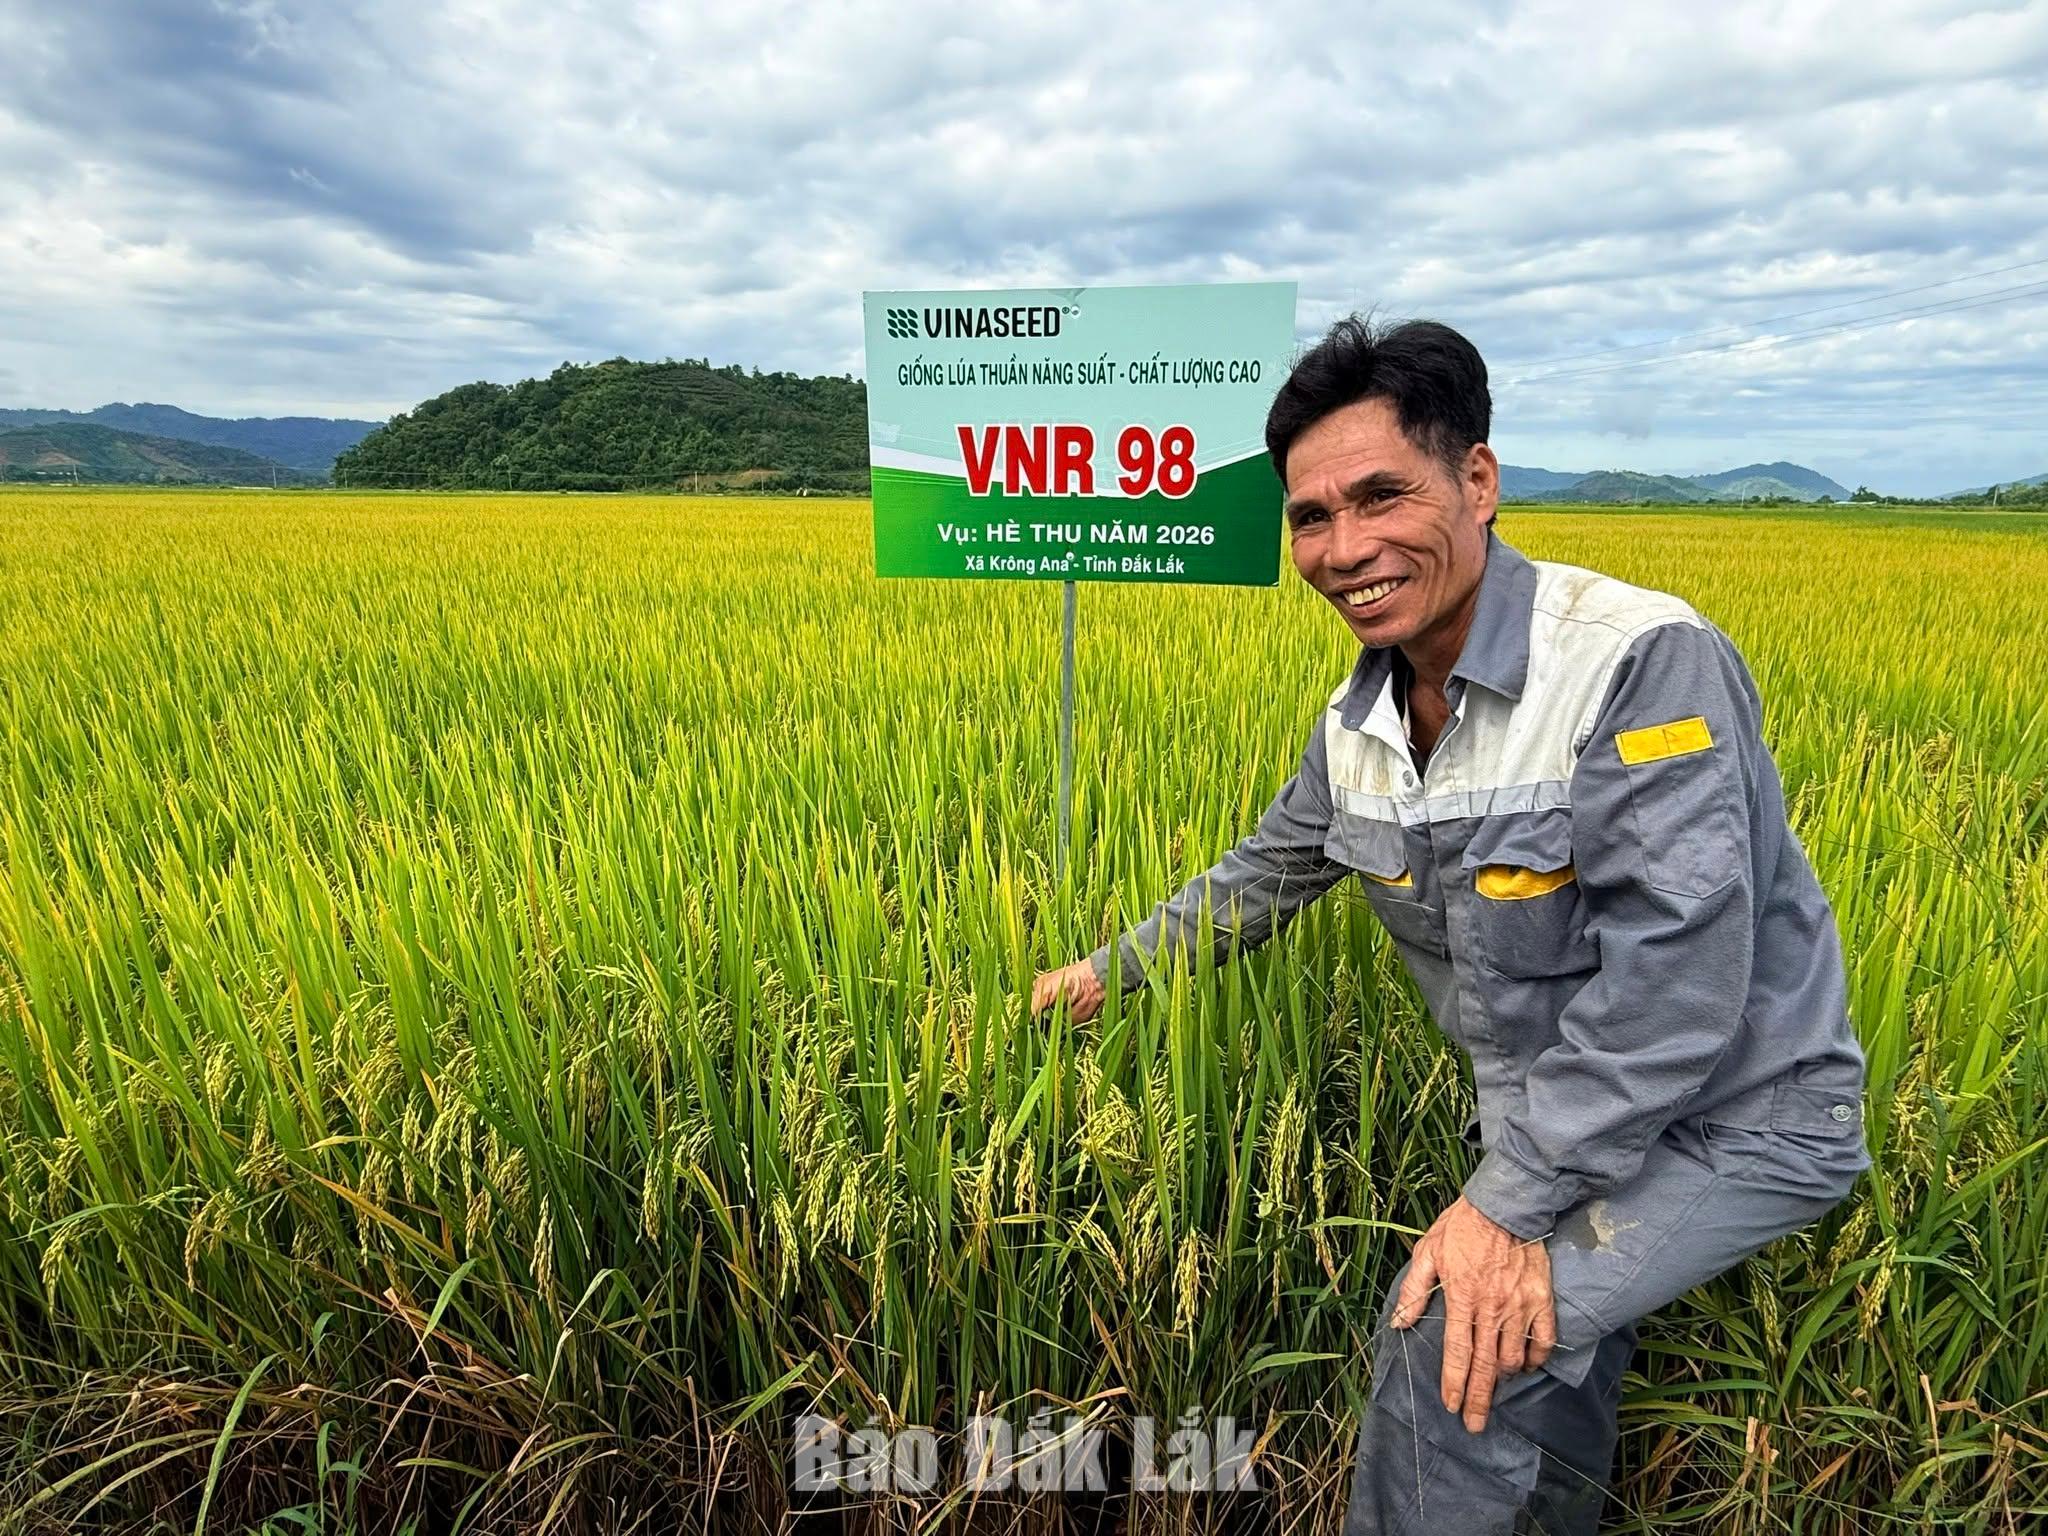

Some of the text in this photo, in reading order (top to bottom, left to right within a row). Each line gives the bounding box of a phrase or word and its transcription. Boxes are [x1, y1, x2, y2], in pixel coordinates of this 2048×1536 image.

[898, 354, 944, 386] GIỐNG
[948, 357, 976, 386] LÚA
[980, 353, 1028, 386] THUẦN
[1032, 357, 1073, 385] NĂNG
[1078, 352, 1116, 385] SUẤT
[1129, 351, 1169, 385] CHẤT
[1173, 358, 1224, 389] LƯỢNG
[1229, 360, 1261, 384] CAO
[956, 424, 1197, 498] VNR 98
[937, 518, 1215, 546] Vụ: HÈ THU NĂM 2026
[965, 554, 985, 571] Xã
[989, 554, 1036, 575] Krông
[1040, 555, 1070, 572] Ana
[1083, 554, 1117, 573] Tỉnh
[1121, 553, 1152, 574] Đắk
[1156, 553, 1185, 574] Lắk
